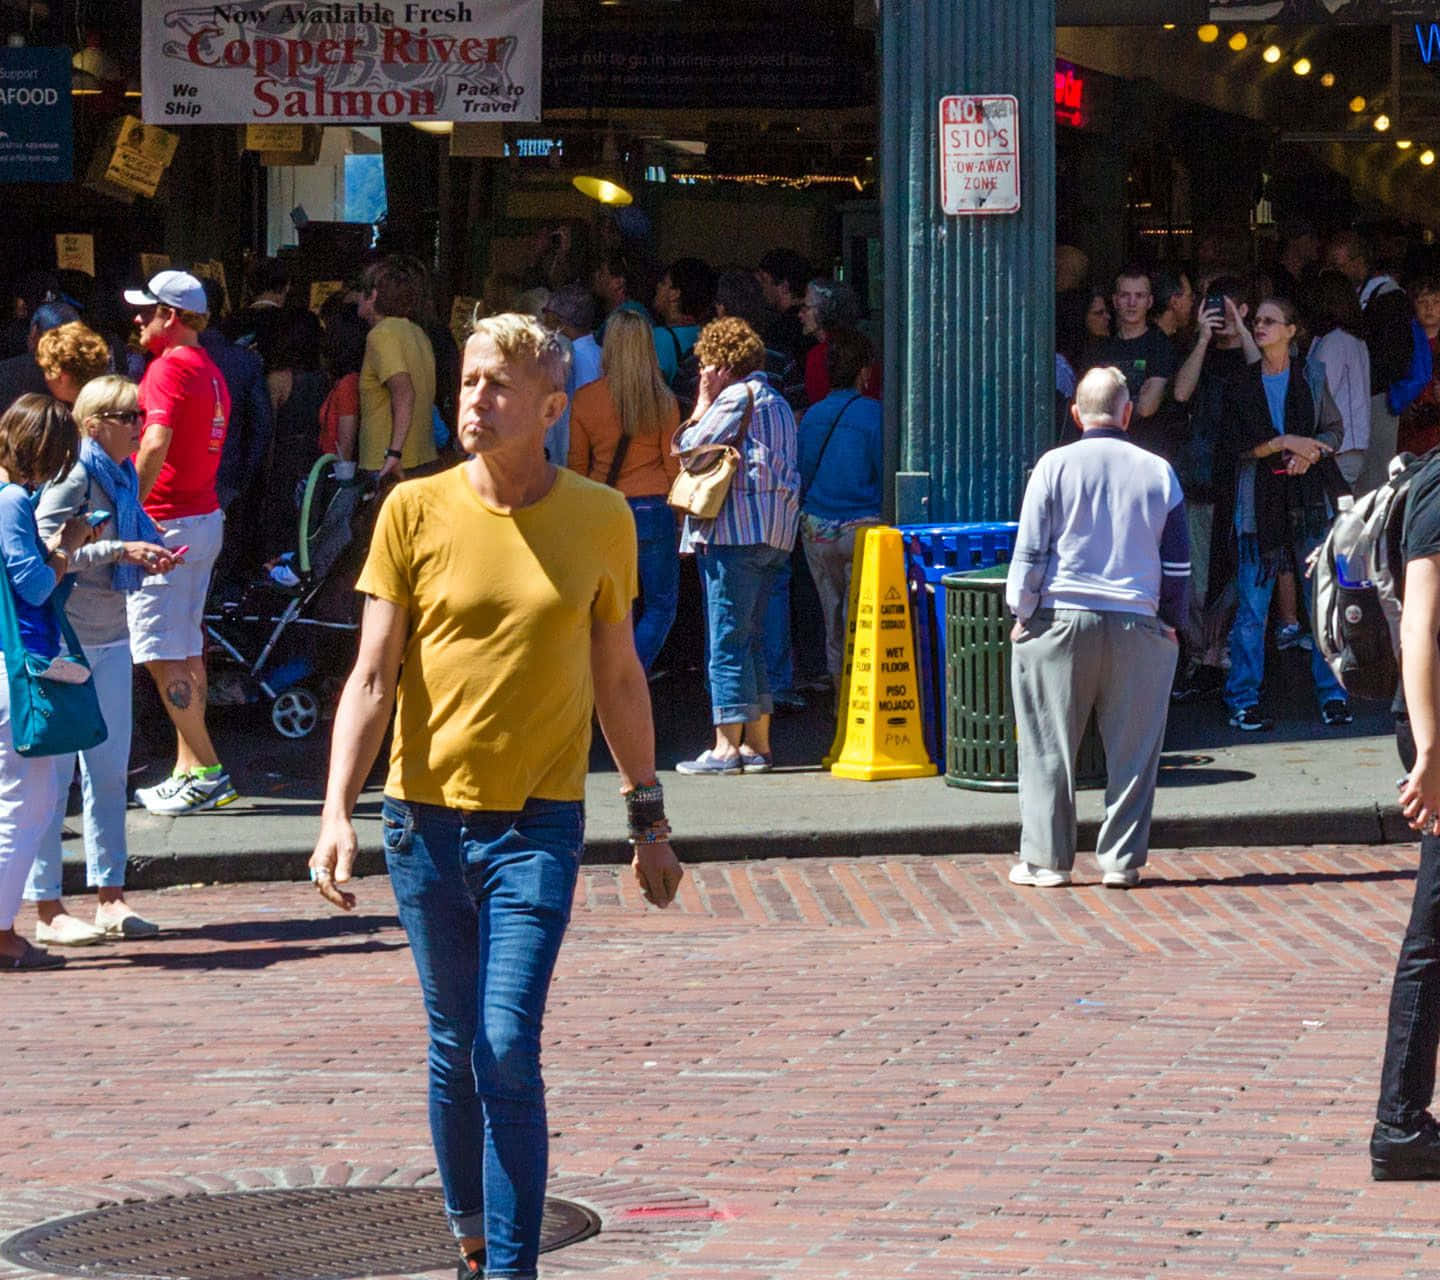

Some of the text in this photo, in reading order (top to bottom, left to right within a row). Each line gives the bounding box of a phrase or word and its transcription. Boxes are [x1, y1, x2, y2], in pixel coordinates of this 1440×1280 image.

[213, 1, 473, 25] Now Available Fresh
[186, 27, 507, 89] Copper River
[0, 68, 39, 82] Support
[171, 84, 198, 98] We
[456, 82, 525, 97] Pack to
[252, 77, 440, 118] Salmon
[164, 100, 202, 117] Ship
[462, 99, 520, 113] Travel
[947, 99, 976, 121] NO
[951, 128, 1009, 149] STOPS
[952, 160, 1012, 174] OW-AWAY
[964, 177, 999, 191] ZONE
[886, 647, 904, 658] WET
[881, 661, 910, 673] FLOOR
[886, 684, 906, 696] PISO
[879, 700, 915, 712] MOJADO
